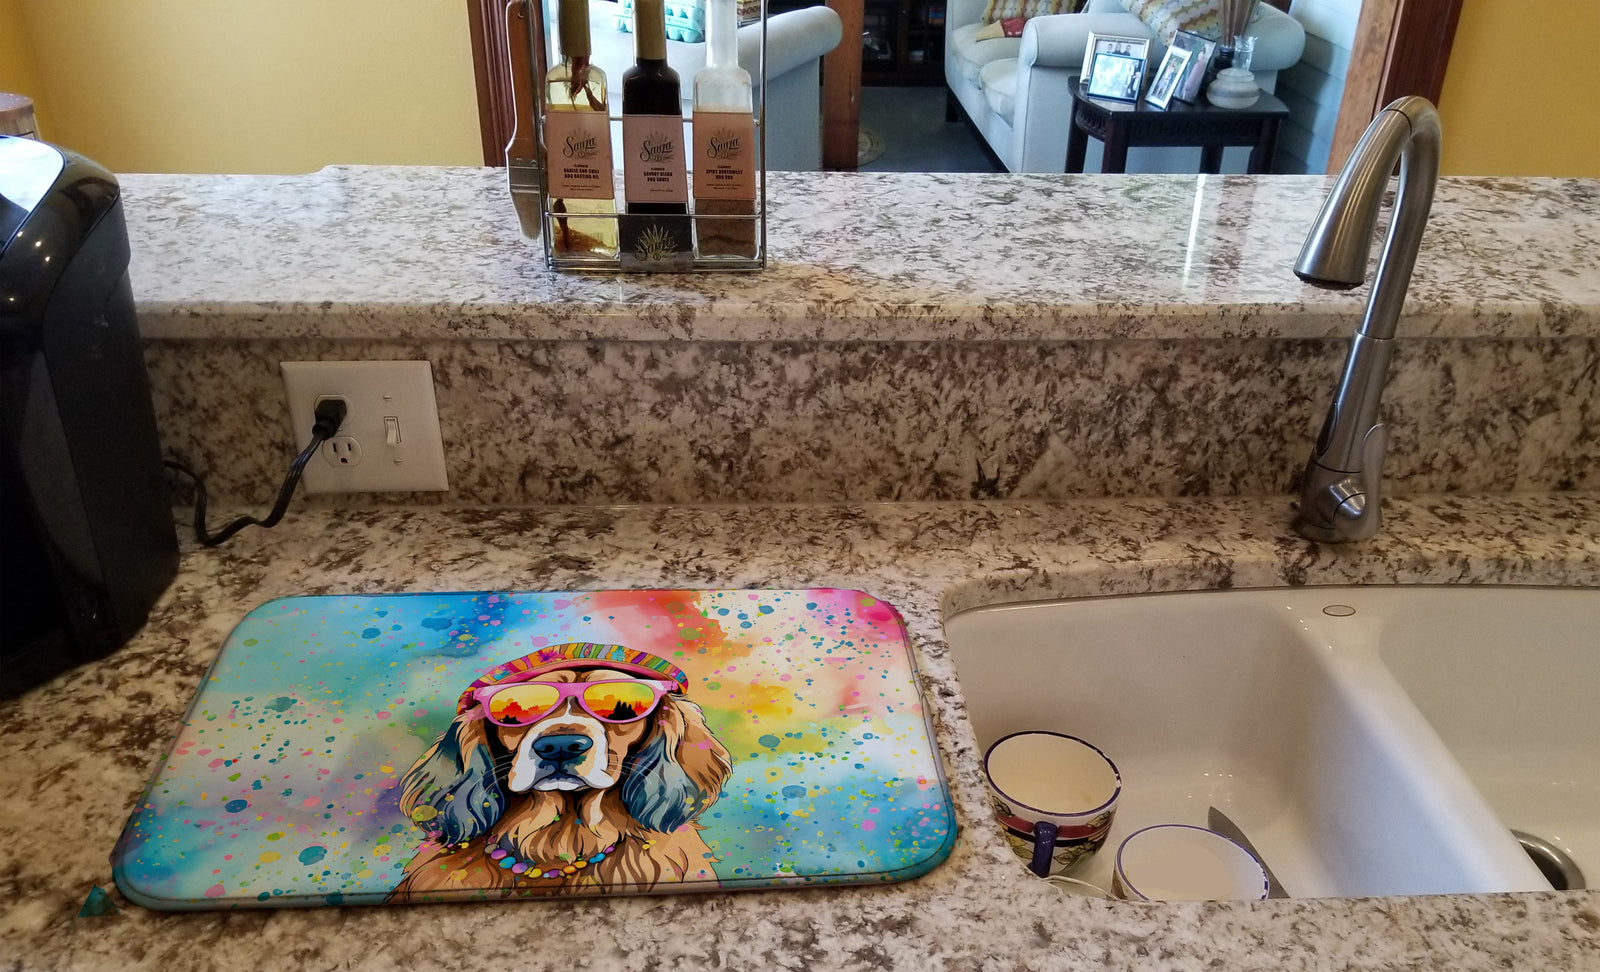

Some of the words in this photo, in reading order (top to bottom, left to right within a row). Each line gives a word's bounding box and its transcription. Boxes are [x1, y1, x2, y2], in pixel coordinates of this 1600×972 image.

[563, 136, 597, 158] Sauza
[640, 140, 674, 161] Sauza
[707, 137, 741, 158] Sauza
